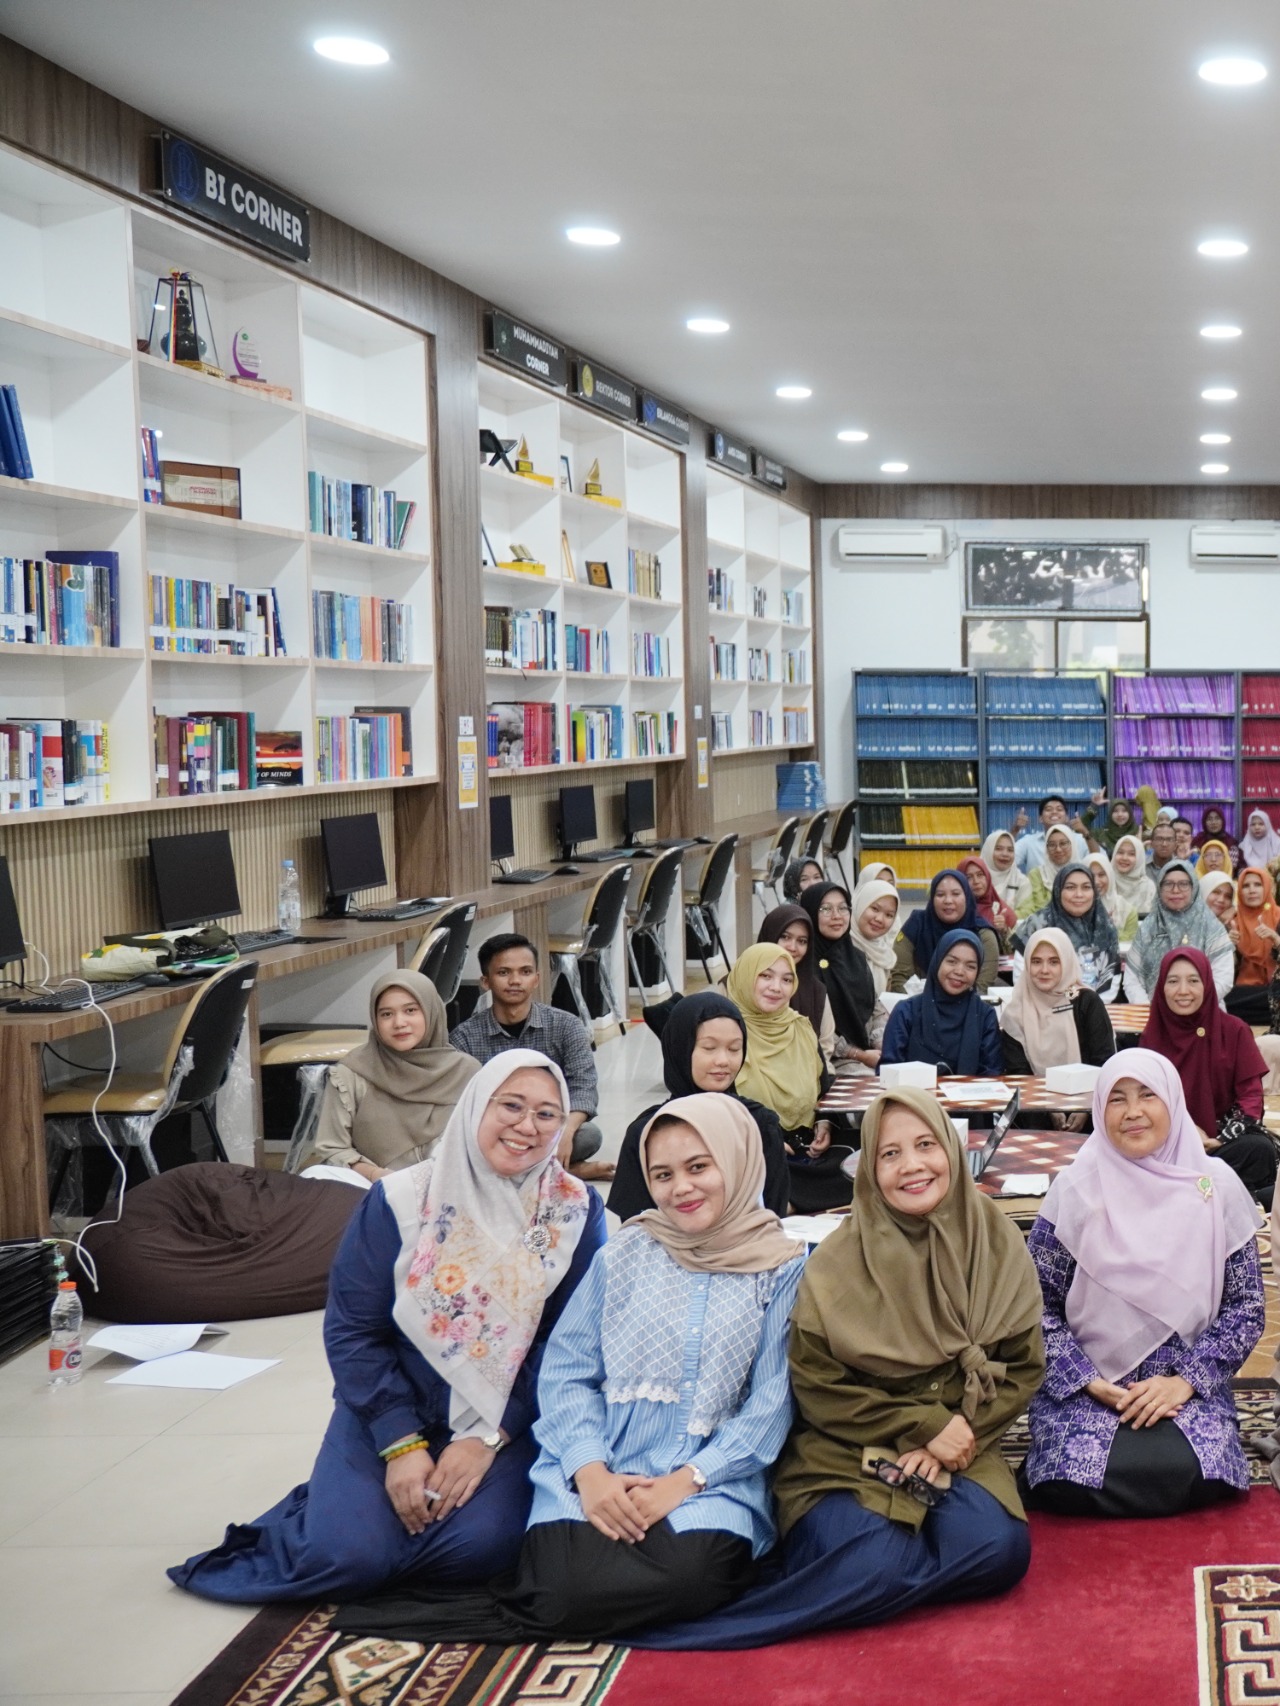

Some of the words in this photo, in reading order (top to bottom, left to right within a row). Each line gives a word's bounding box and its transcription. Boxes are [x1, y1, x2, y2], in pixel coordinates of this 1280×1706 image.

[205, 166, 227, 206] BI
[231, 182, 303, 247] CORNER
[513, 325, 559, 360] MUHAMMADIYAH
[526, 353, 550, 376] CORNER
[596, 380, 614, 399] REKTOR
[614, 388, 631, 408] CORNER
